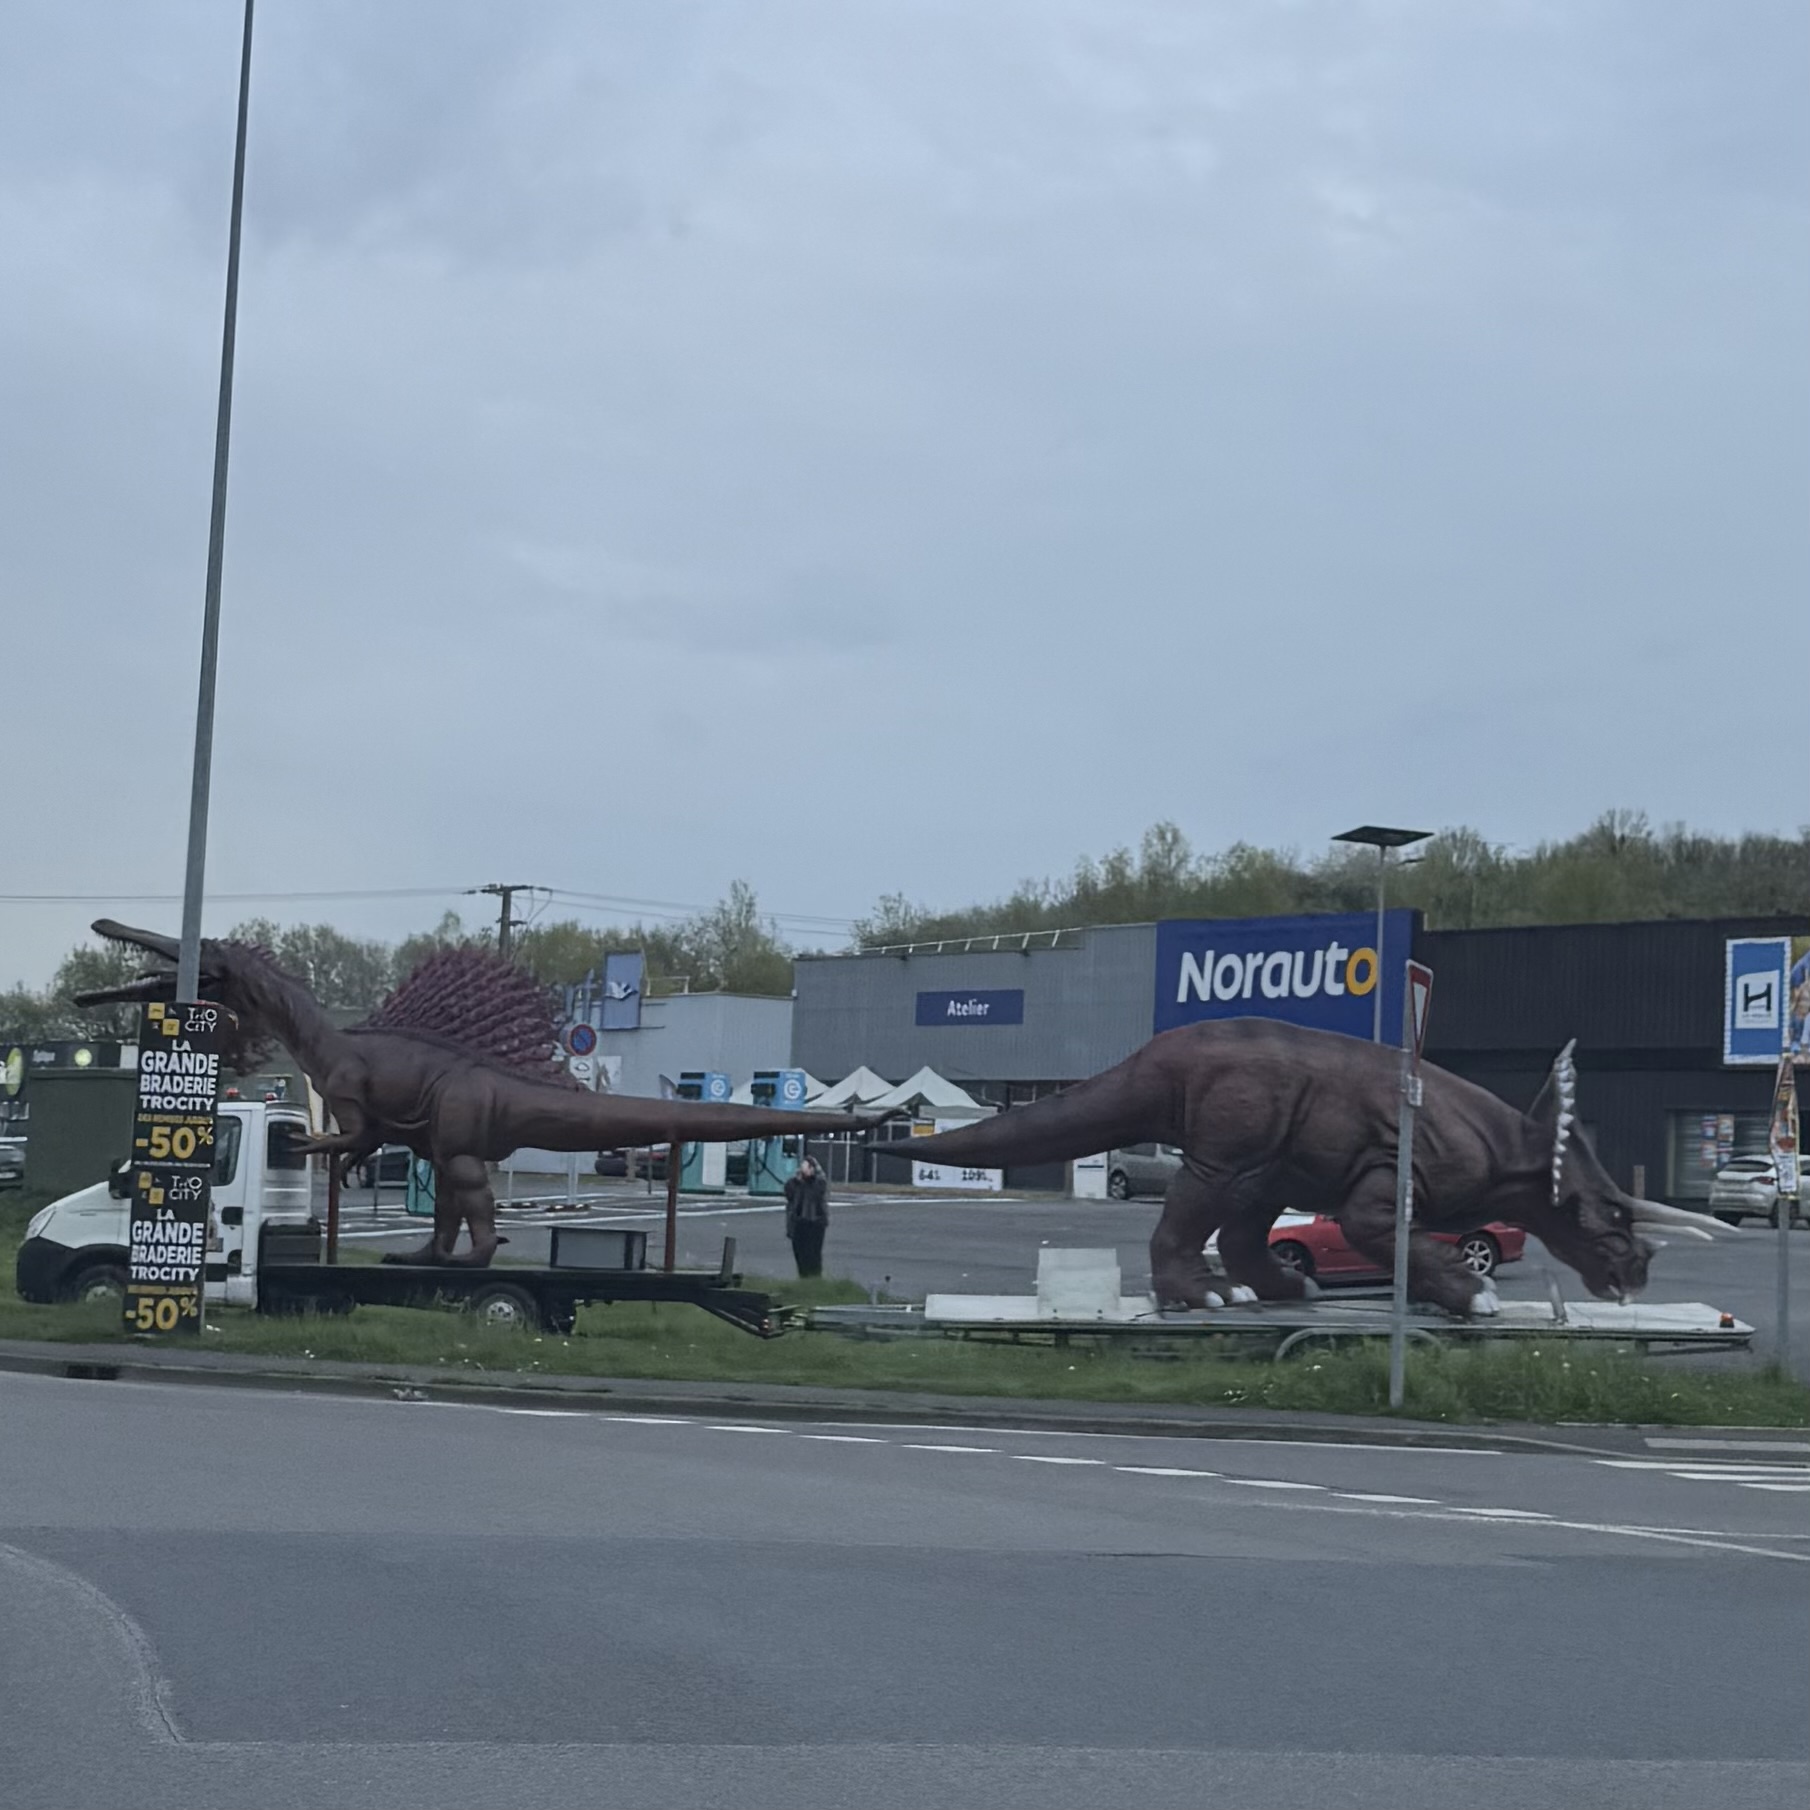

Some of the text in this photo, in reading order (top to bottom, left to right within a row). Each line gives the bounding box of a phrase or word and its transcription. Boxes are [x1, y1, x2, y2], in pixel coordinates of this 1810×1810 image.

[1176, 941, 1379, 1003] Norauto
[947, 998, 990, 1017] Atelier
[172, 1039, 191, 1051] LA
[141, 1050, 219, 1075] GRANDE
[140, 1074, 216, 1095] BRADERIE
[139, 1094, 214, 1111] TROCITY
[135, 1126, 213, 1159] -50%
[169, 1188, 202, 1200] CITY
[157, 1208, 175, 1220] LA
[132, 1220, 204, 1244] GRANDE
[131, 1244, 202, 1264] BRADERIE
[130, 1265, 199, 1281] TROCITY
[125, 1296, 198, 1330] -50%
